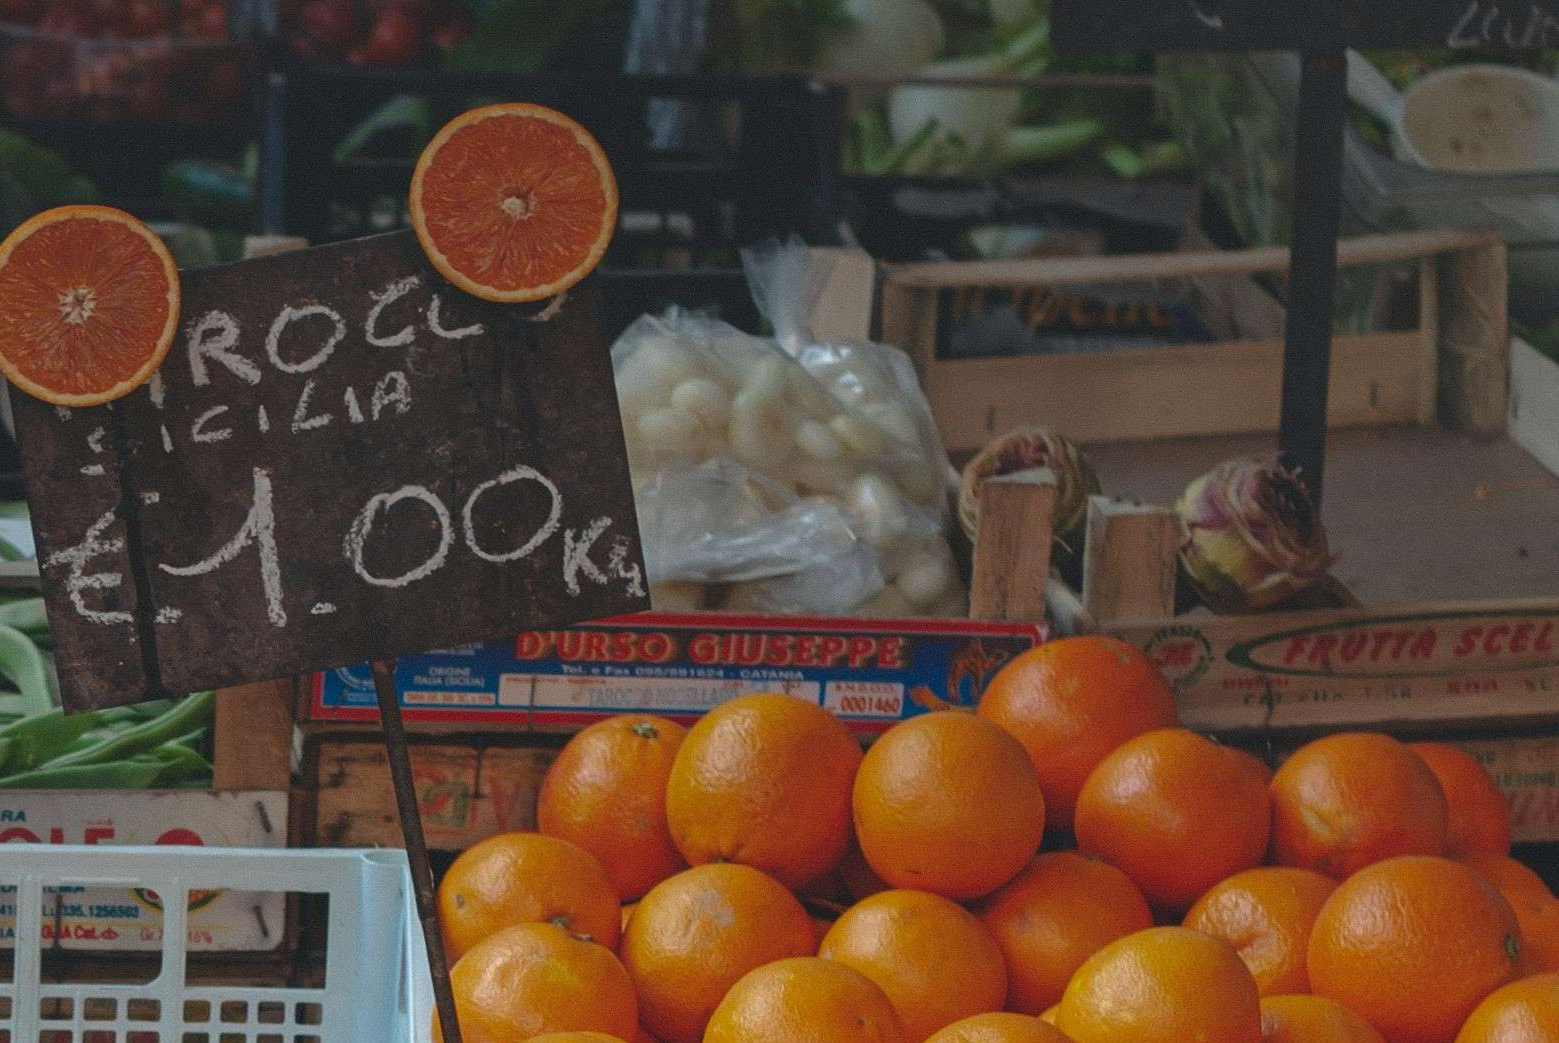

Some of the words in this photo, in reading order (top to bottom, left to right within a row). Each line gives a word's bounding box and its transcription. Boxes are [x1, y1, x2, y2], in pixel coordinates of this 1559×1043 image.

[516, 631, 675, 663] D'URSO
[689, 634, 908, 668] GIUSEPPE
[1282, 624, 1436, 665] FRUTTA
[739, 669, 805, 680] CATANIA
